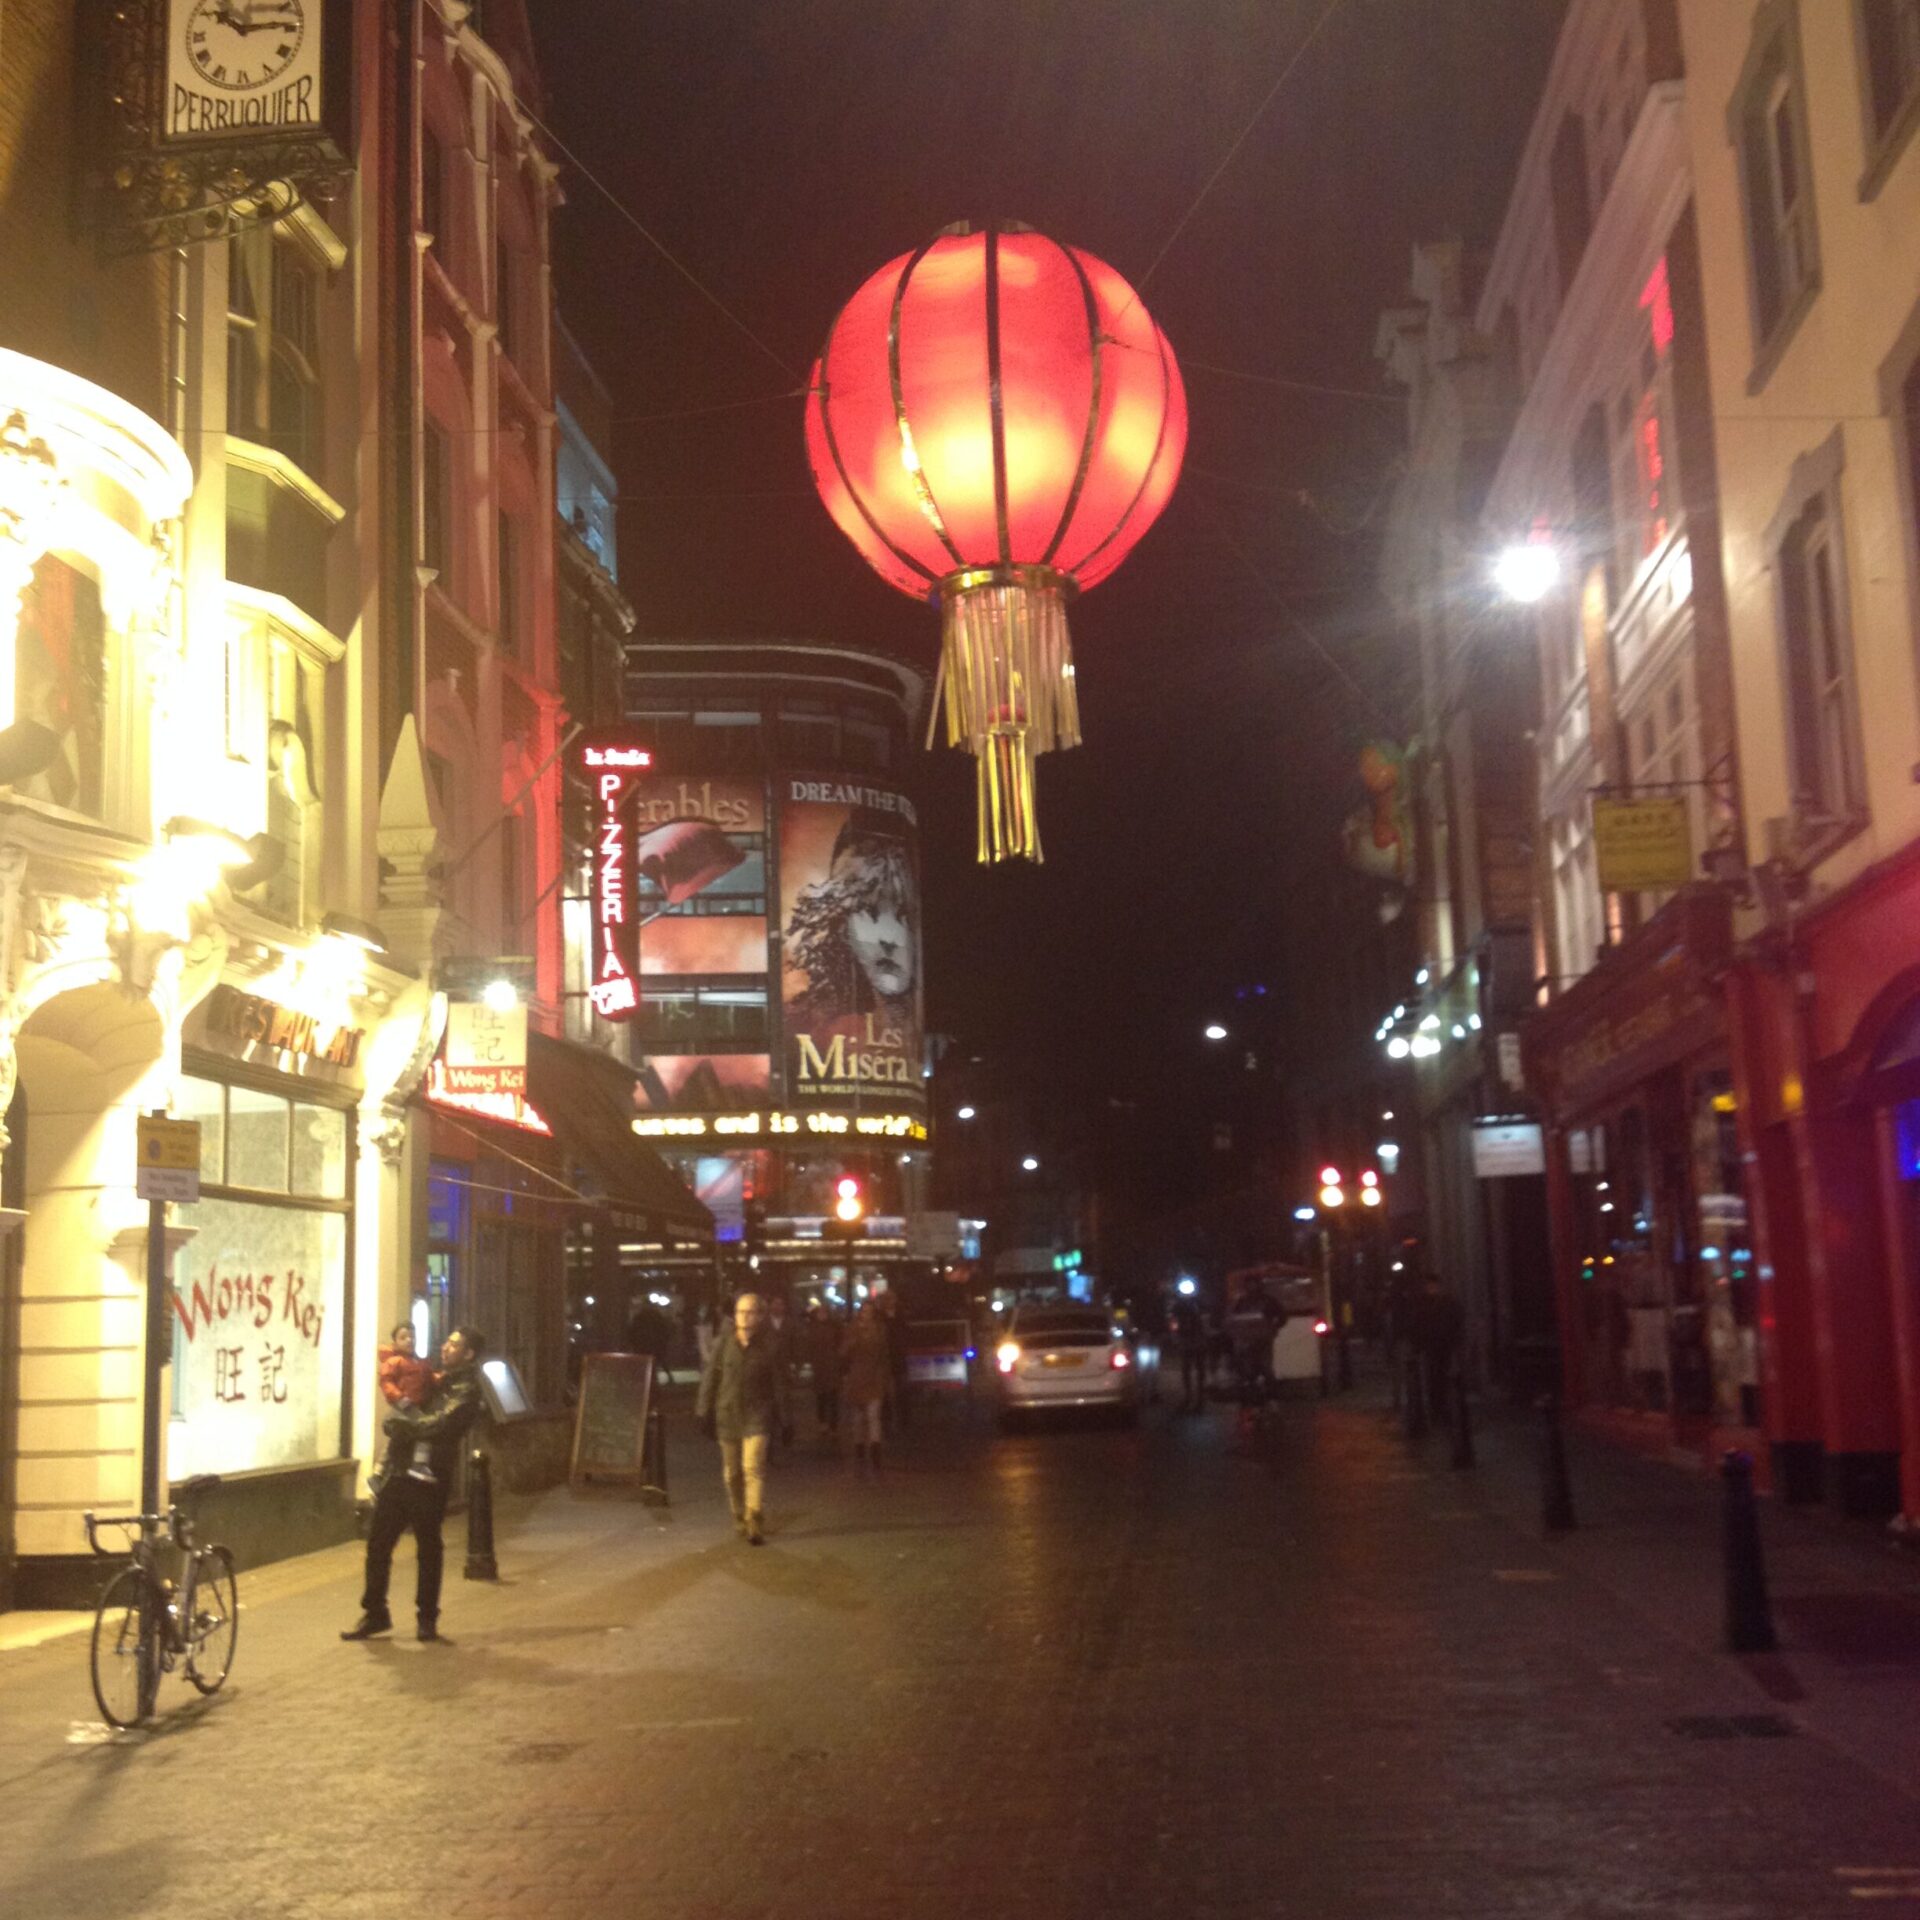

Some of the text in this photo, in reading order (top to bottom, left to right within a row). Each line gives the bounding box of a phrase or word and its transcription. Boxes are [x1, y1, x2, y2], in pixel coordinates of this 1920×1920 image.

[173, 74, 313, 134] PERRUQUIER
[790, 780, 862, 804] DREAM
[864, 787, 896, 812] THE
[600, 774, 625, 979] PIZZERIA
[864, 1011, 903, 1049] Les
[448, 1068, 524, 1092] Wong Kei
[795, 1033, 924, 1088] Miséra
[714, 1112, 760, 1134] and
[769, 1111, 799, 1133] is
[806, 1111, 849, 1133] the
[172, 1262, 325, 1349] Wong Kei
[214, 1341, 288, 1404] 旺記
